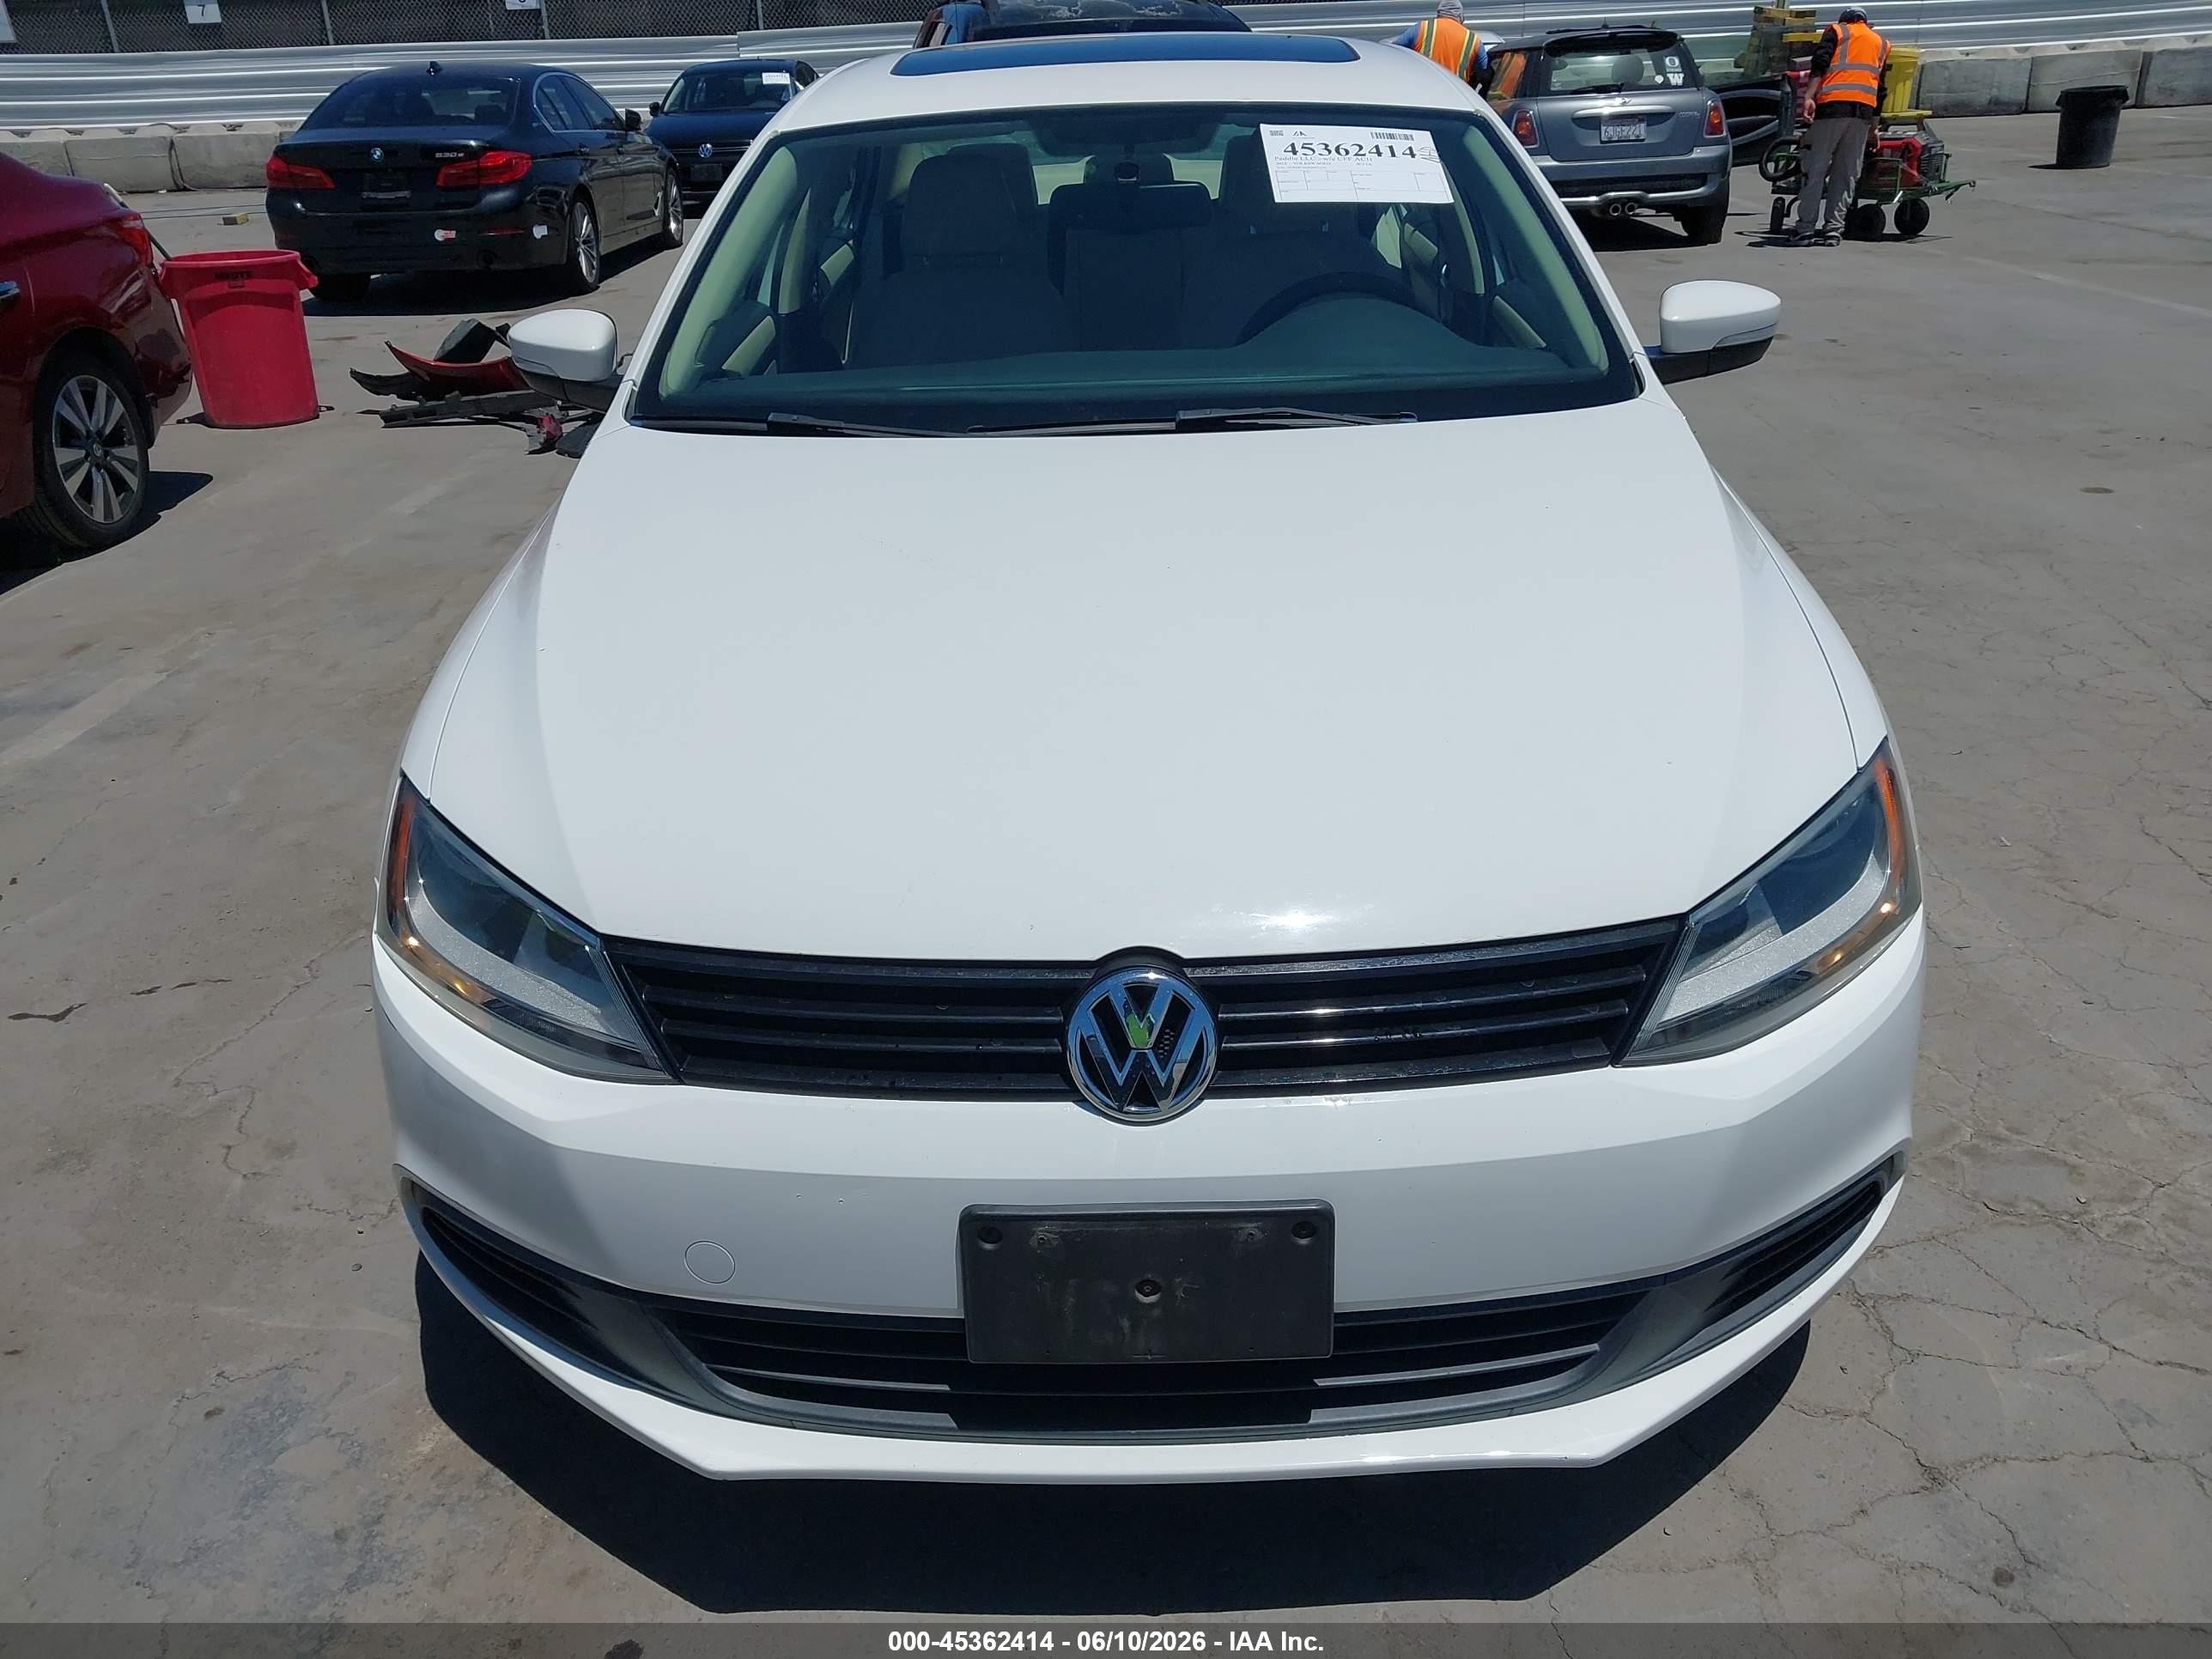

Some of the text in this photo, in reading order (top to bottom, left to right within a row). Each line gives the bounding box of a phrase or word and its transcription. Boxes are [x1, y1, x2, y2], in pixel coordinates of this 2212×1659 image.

[198, 4, 205, 17] 7
[1667, 73, 1684, 85] W
[1283, 142, 1417, 158] 45362414
